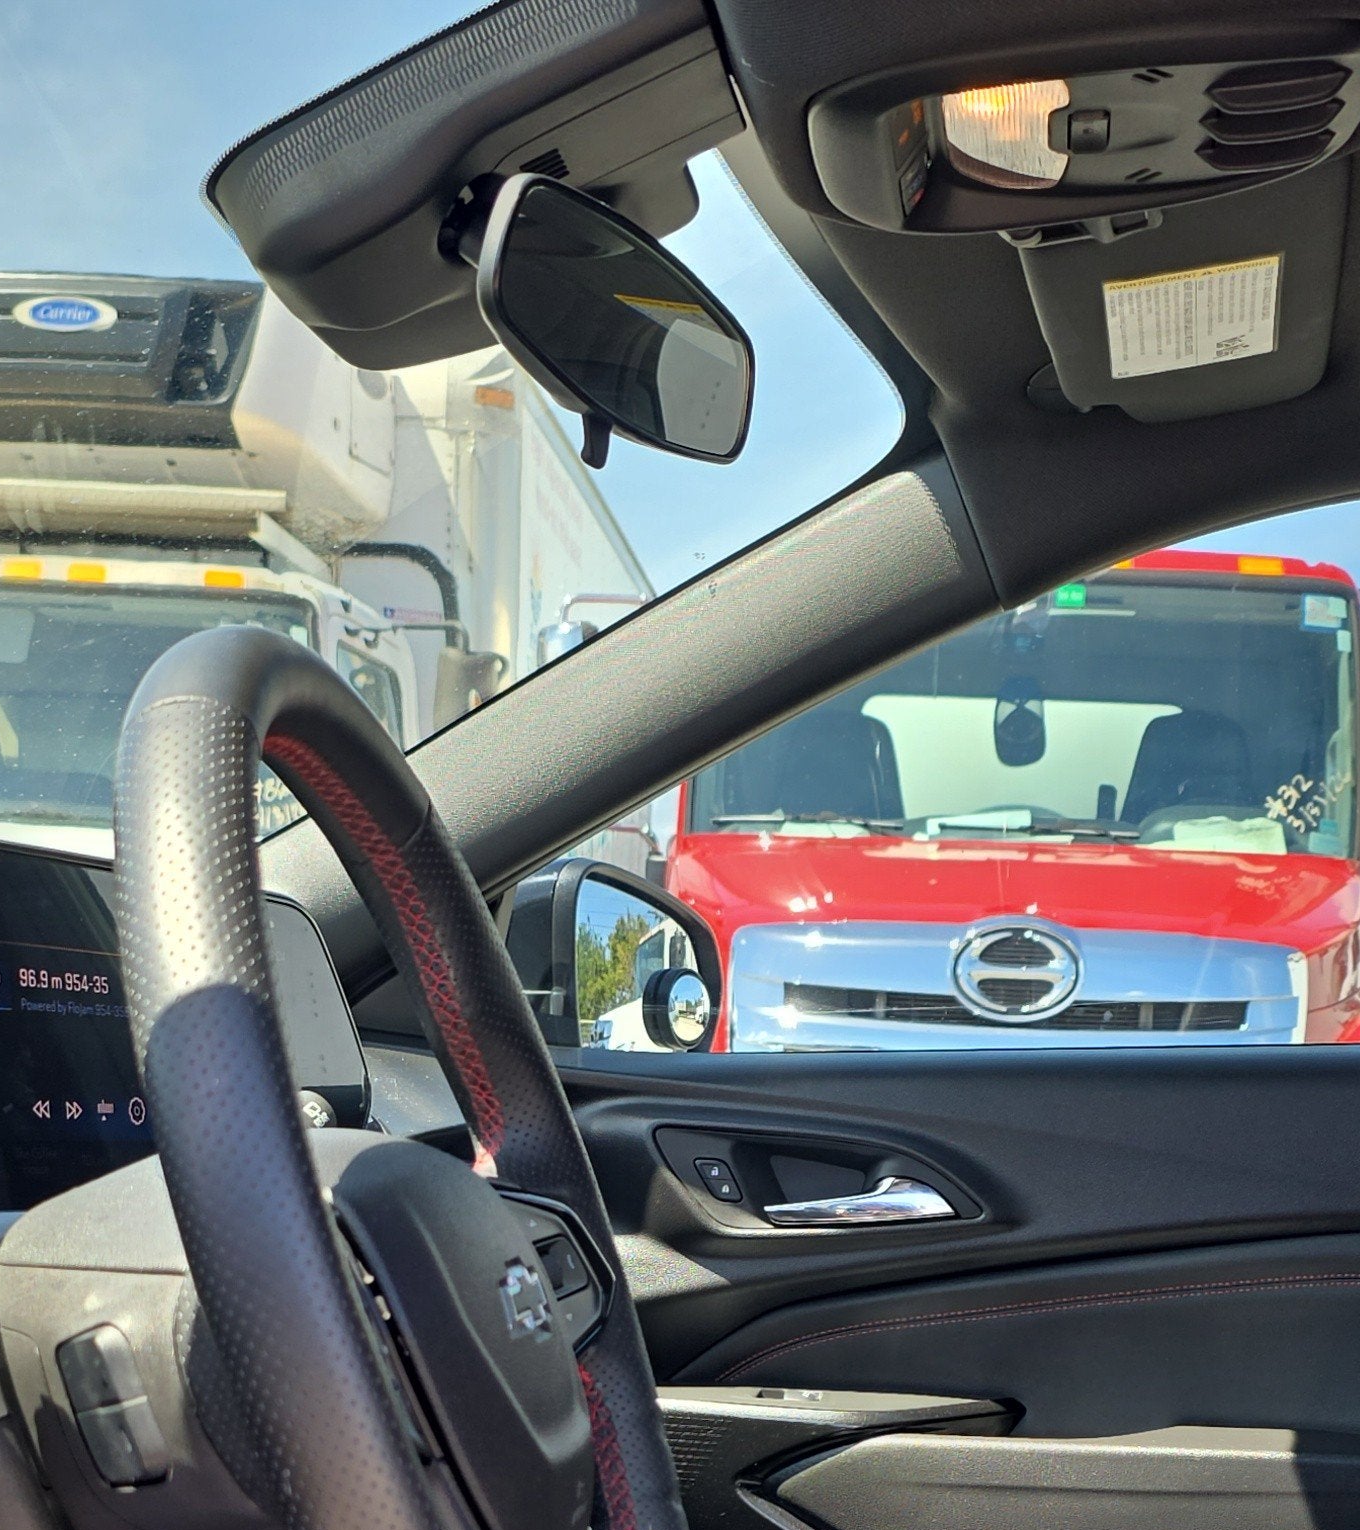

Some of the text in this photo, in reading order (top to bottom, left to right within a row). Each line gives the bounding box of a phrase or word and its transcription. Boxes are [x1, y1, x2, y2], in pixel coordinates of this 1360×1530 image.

[1217, 259, 1272, 273] WARNING
[38, 304, 92, 321] Carrier
[18, 967, 49, 989] 96.9
[65, 972, 109, 994] 954-35
[20, 997, 56, 1013] Powered
[57, 1000, 67, 1016] by
